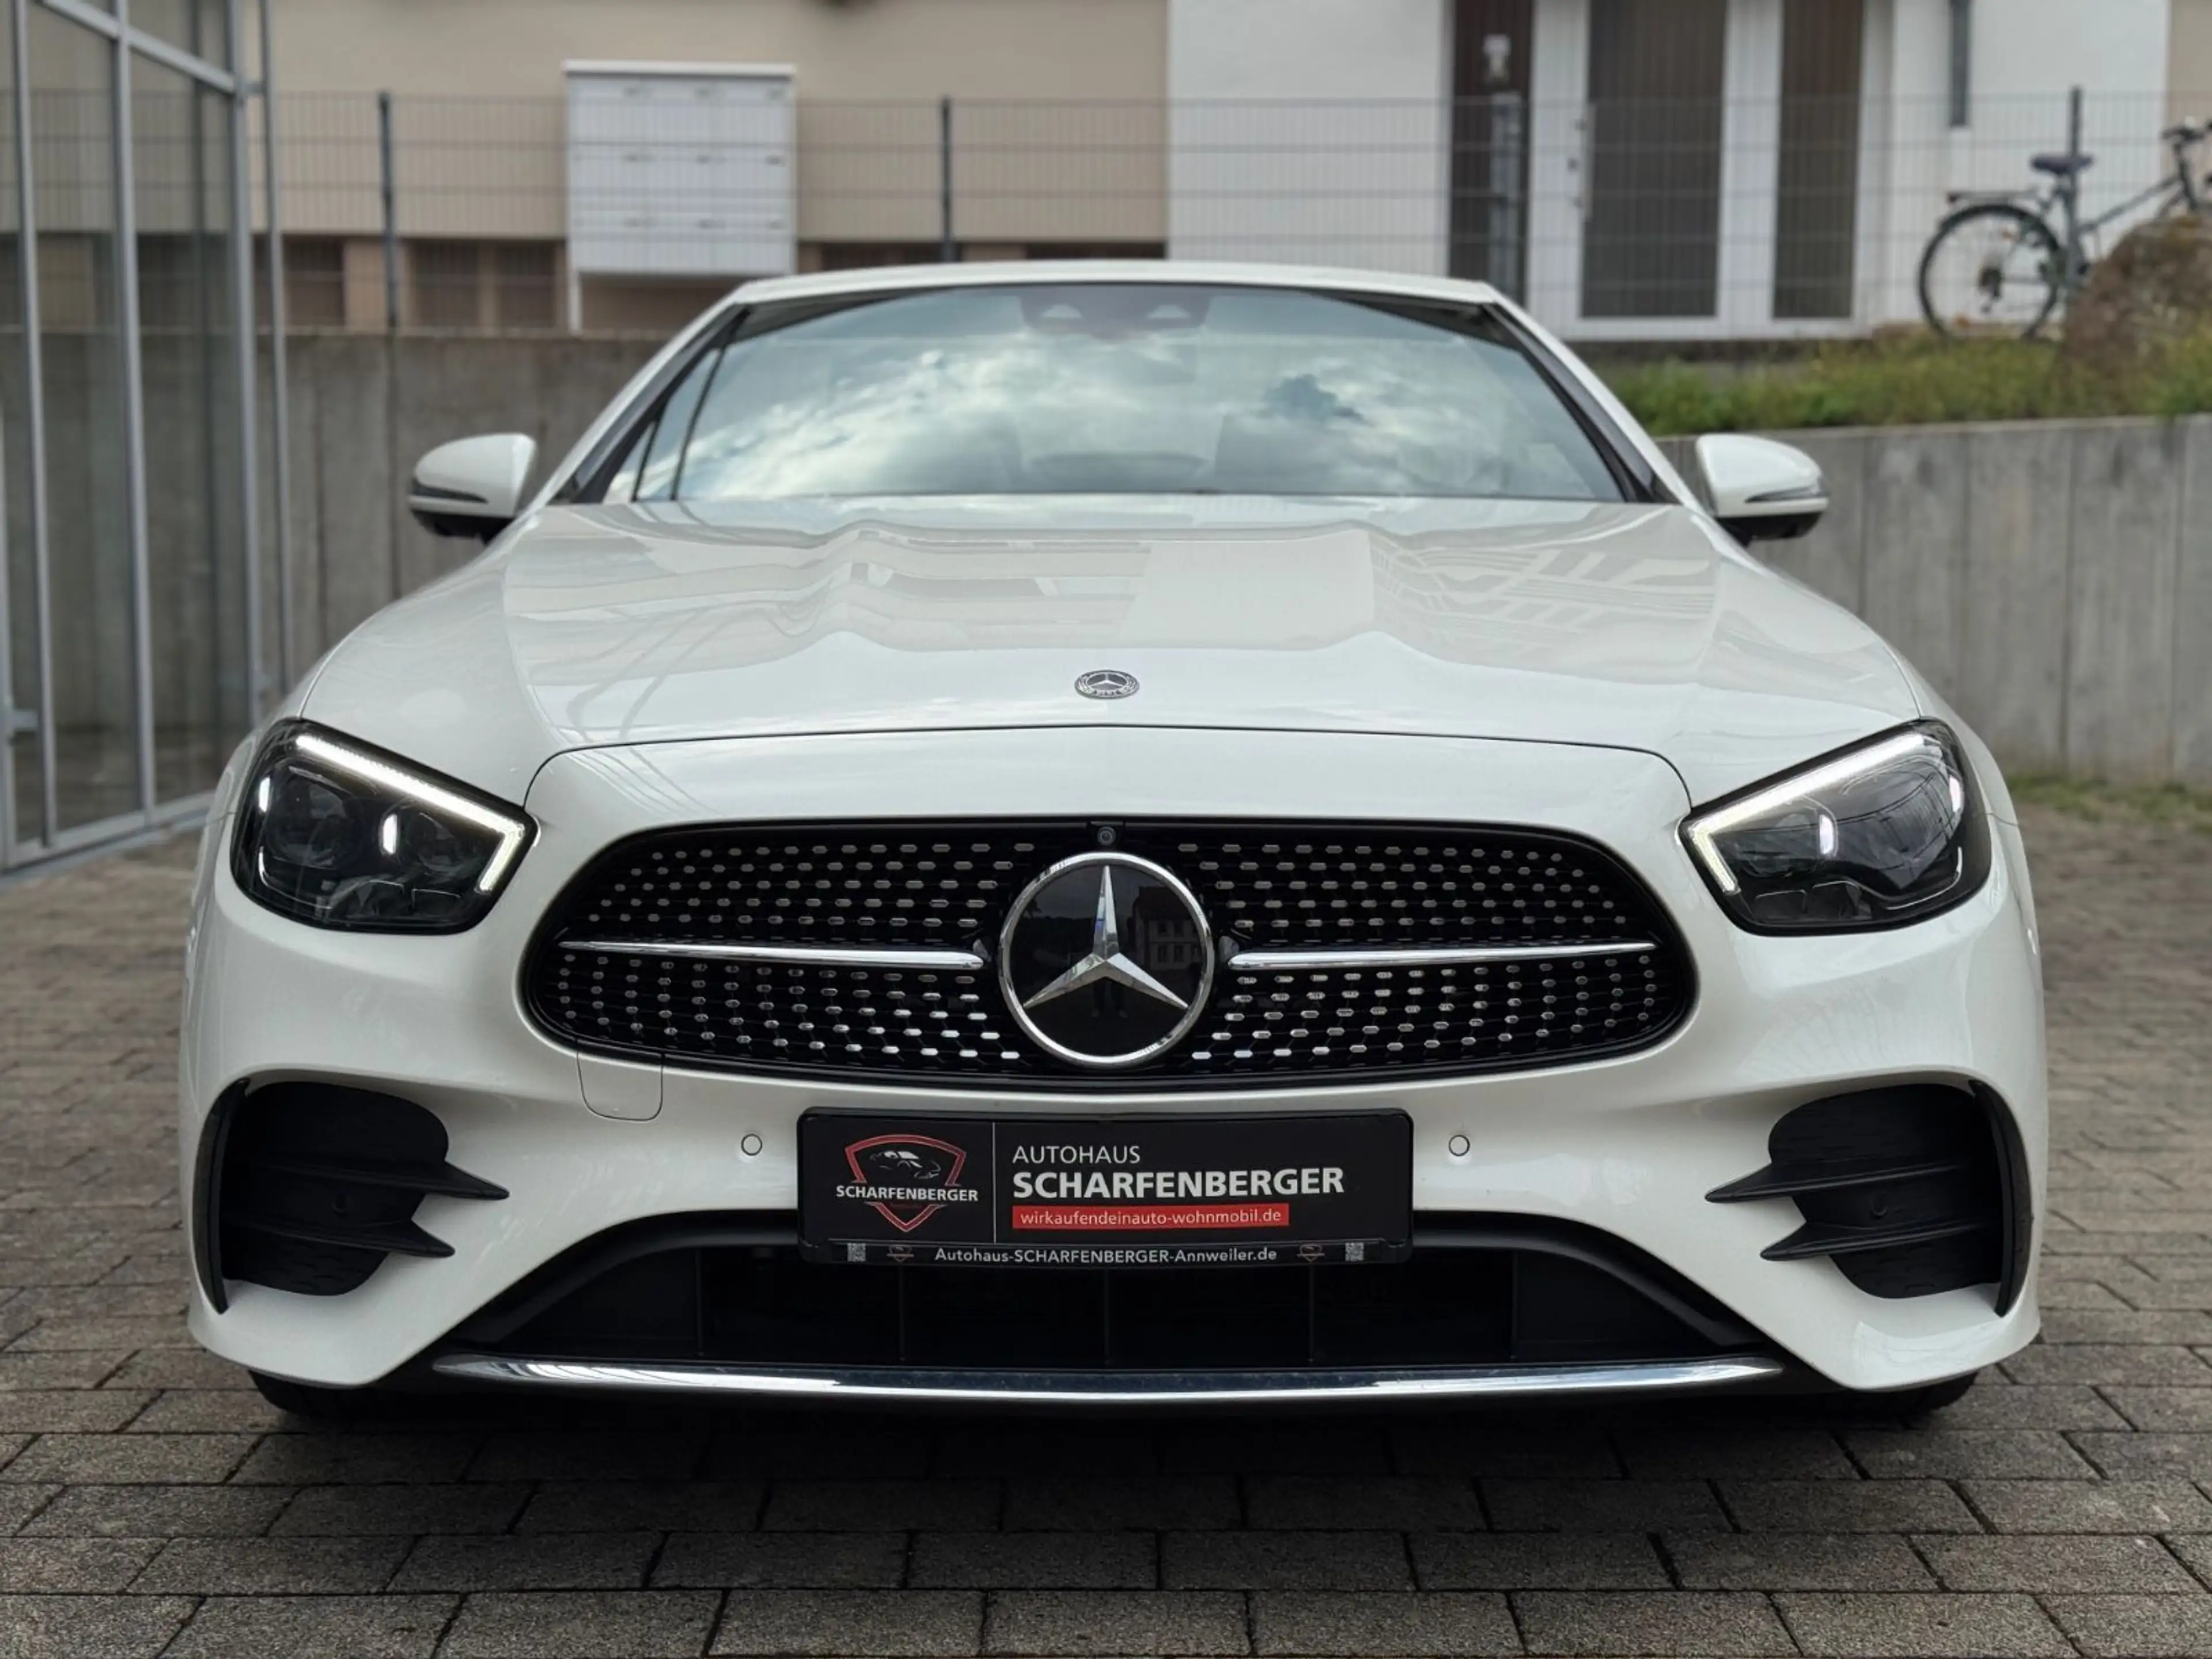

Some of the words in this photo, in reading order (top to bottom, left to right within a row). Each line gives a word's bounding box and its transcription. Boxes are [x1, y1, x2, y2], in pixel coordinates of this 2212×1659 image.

[1012, 1145, 1141, 1164] AUTOHAUS
[1013, 1167, 1344, 1198] SCHARFENBERGER
[836, 1185, 978, 1202] SCHARFENBERGER
[1020, 1209, 1281, 1225] wirkaufendeinauto-wohnmobil.de
[934, 1247, 1277, 1263] Autohaus-SCHARFENBERGER-Annweiler.de
